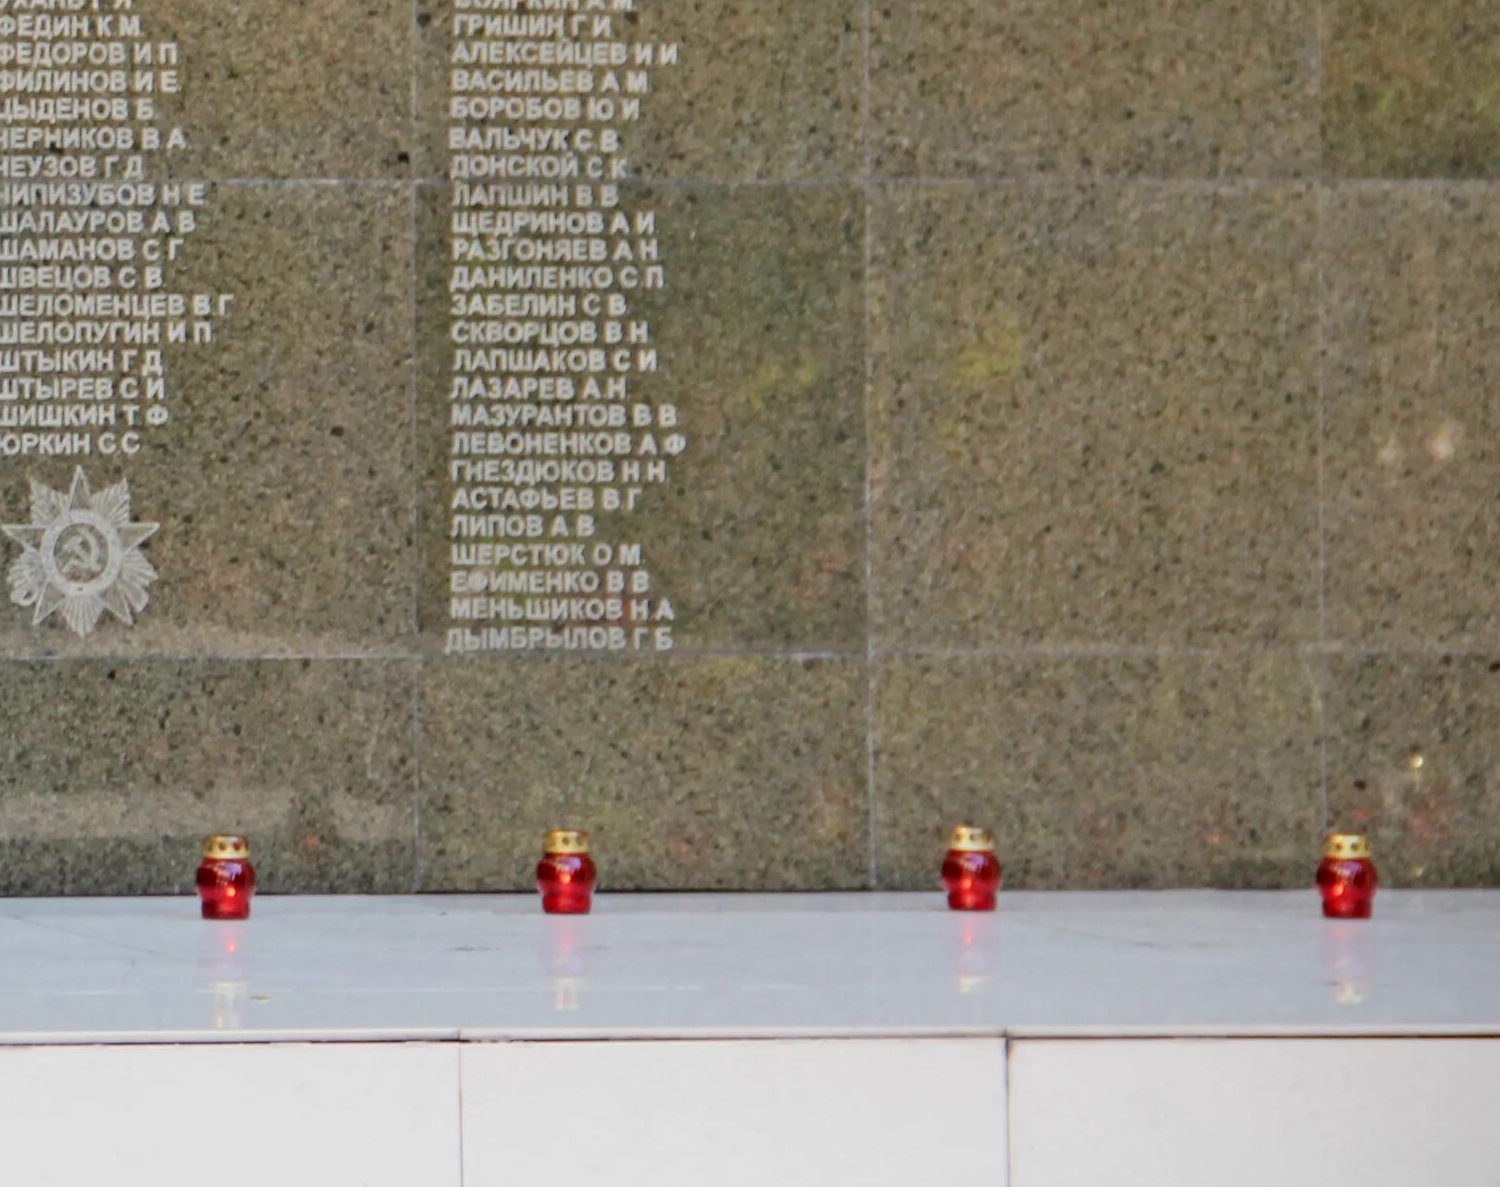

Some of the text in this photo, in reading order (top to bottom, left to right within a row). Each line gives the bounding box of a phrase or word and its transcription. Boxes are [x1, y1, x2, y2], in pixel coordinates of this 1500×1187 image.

[454, 15, 563, 36] ГРИШИН
[452, 39, 626, 67] АЛЕКСЕЙЦЕВ
[451, 71, 593, 93] ВАСИЛЬЕВ
[449, 128, 568, 151] ВАЛЬЧУК
[450, 153, 578, 178] ДОНСКОЙ
[453, 184, 567, 207] ЛАПШИН
[452, 212, 603, 237] ЩЕДРИНОВ
[452, 240, 606, 261] РАЗГОНЯЕВ
[449, 266, 613, 292] ДАНИЛЕНКО
[451, 294, 575, 316] ЗАБЕЛИН
[452, 322, 597, 346] СКВОРЦОВ
[453, 349, 605, 371] ЛАПШАКОВ
[450, 377, 574, 399] ЛАЗАРЕВ
[452, 404, 626, 427] МАЗУРАНТОВ
[452, 433, 631, 454] ЛЕВОНЕНКОВ
[452, 460, 614, 485] ГНЕЗДЮКОВ
[452, 487, 593, 510] АСТАФЬЕВ
[452, 544, 585, 565] ШЕРСТЮК
[451, 598, 622, 620] МЕНЬШИКОВ
